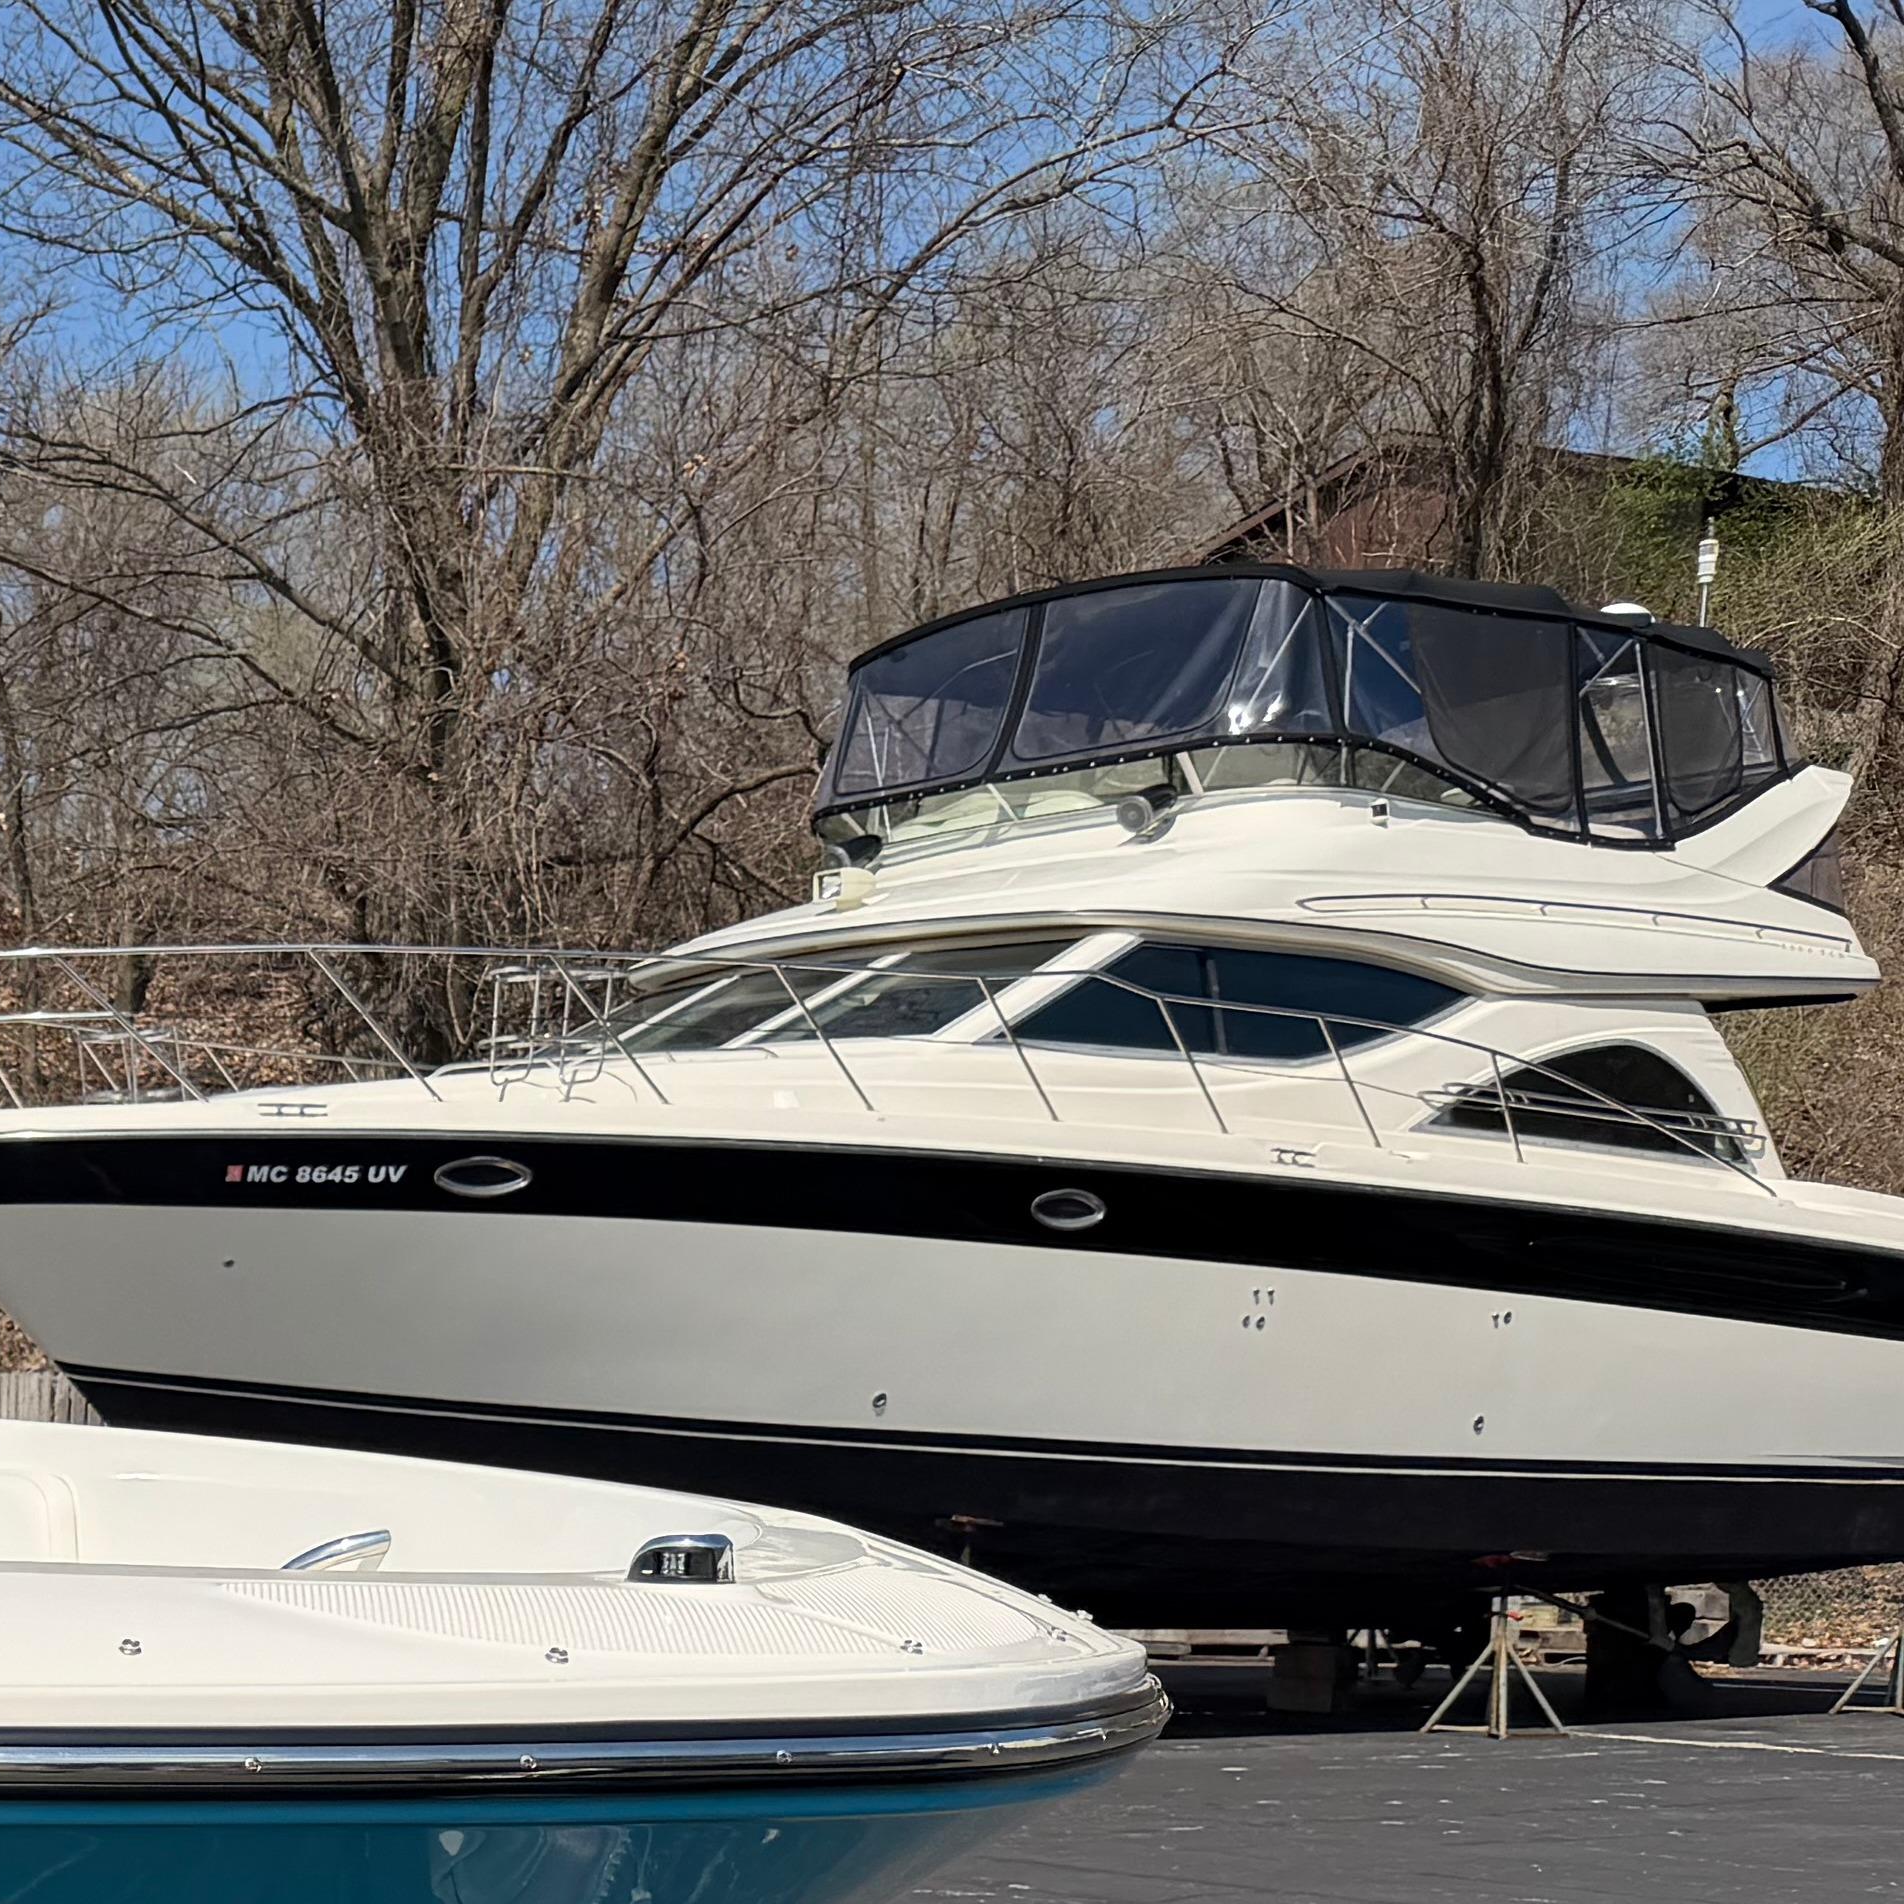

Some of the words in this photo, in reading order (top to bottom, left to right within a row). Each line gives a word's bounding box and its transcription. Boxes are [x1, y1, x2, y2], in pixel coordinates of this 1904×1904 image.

[246, 1164, 289, 1183] MC
[295, 1164, 360, 1183] 8645
[367, 1164, 409, 1183] UV
